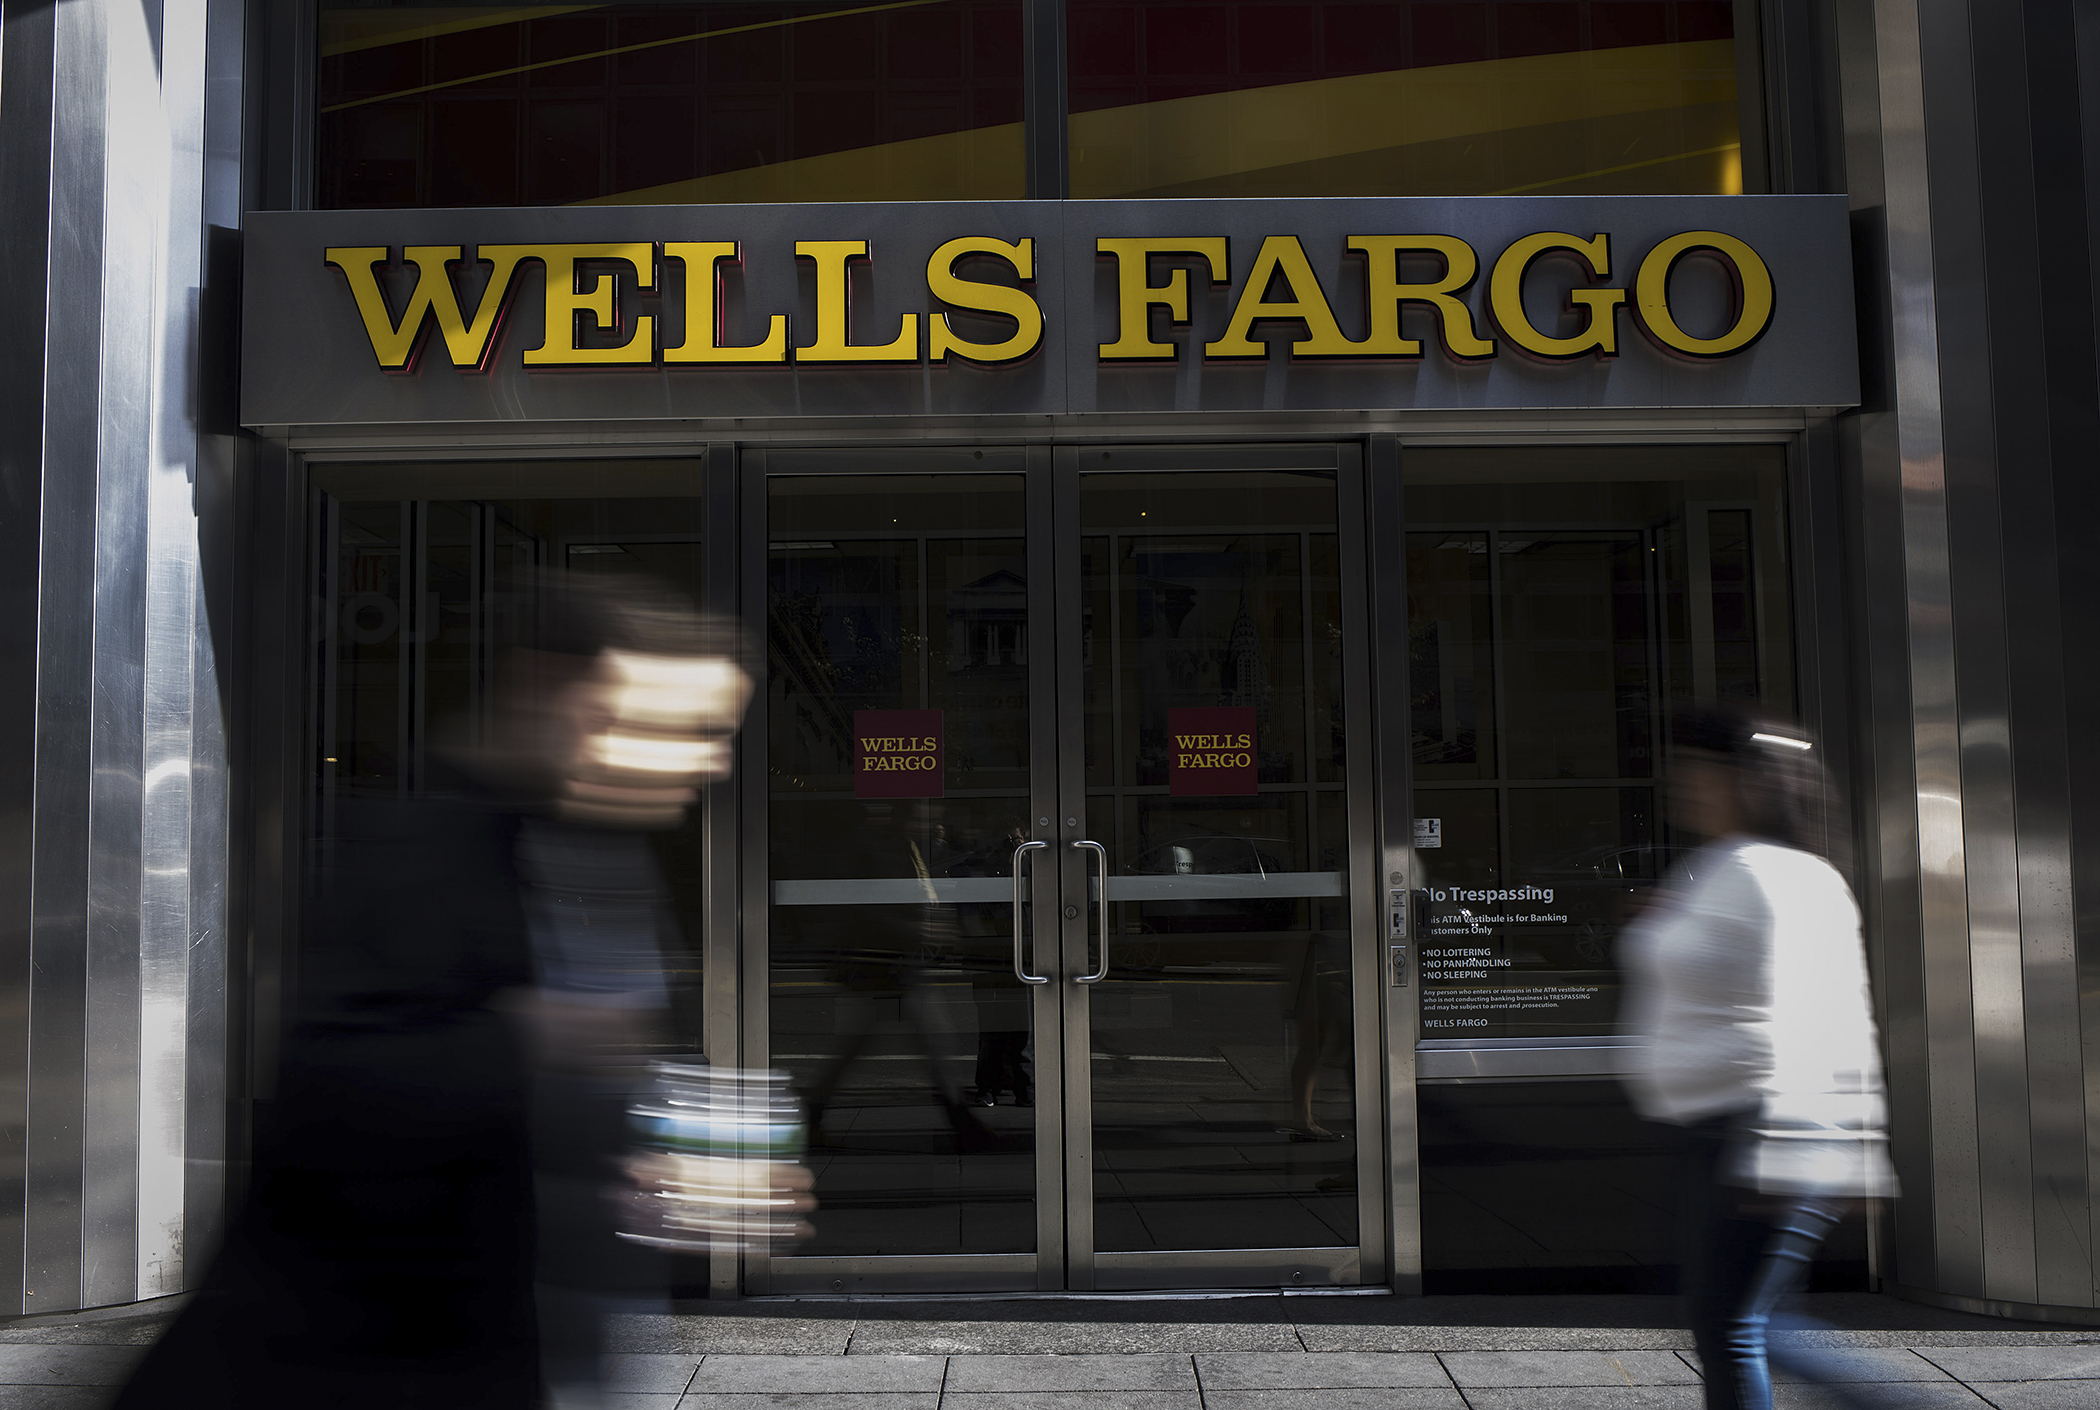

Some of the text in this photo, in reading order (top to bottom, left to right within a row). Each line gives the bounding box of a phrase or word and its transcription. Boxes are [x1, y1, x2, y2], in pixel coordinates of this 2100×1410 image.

[325, 230, 1772, 369] WELLS FARGO
[860, 736, 937, 752] WELLS
[1174, 734, 1251, 750] WELLS
[862, 755, 937, 771] FARGO
[1177, 752, 1251, 769] FARGO
[1449, 886, 1554, 905] Trespassing
[1441, 915, 1461, 924] ATM
[1462, 914, 1504, 924] Vestibule
[1506, 914, 1514, 923] is
[1515, 914, 1529, 923] for
[1530, 913, 1567, 924] Banking
[1431, 925, 1493, 936] stomers Only
[1427, 948, 1491, 957] NO LOITERING
[1427, 958, 1511, 968] NO PANHANDLING
[1427, 970, 1487, 979] NO SLEEPING
[1490, 995, 1516, 1003] banking
[1424, 1018, 1489, 1028] WELLS FARGO
